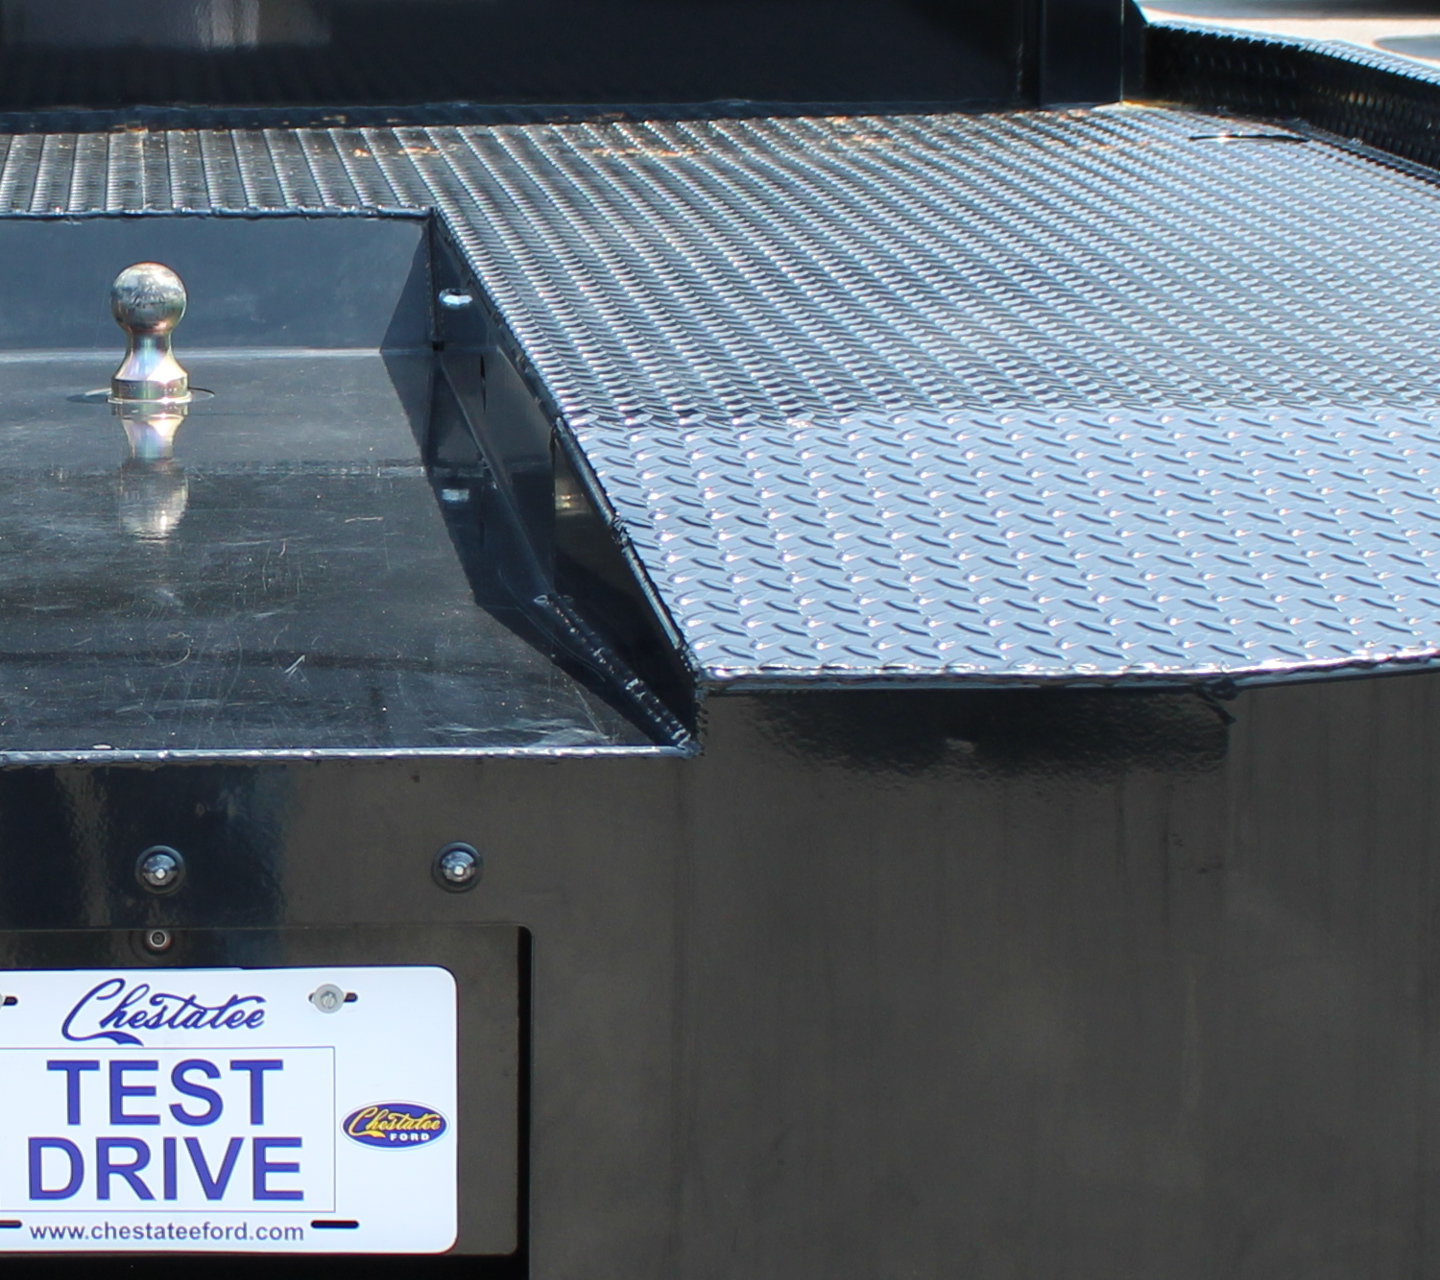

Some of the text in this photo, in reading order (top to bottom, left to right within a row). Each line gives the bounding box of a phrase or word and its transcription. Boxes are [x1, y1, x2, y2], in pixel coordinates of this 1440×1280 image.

[61, 977, 267, 1047] Chestatee
[46, 1058, 284, 1127] TEST
[348, 1106, 442, 1138] Chestatee
[389, 1132, 431, 1142] FORD
[27, 1136, 305, 1202] DRIVE
[29, 1221, 305, 1241] www.chestateeford.com
